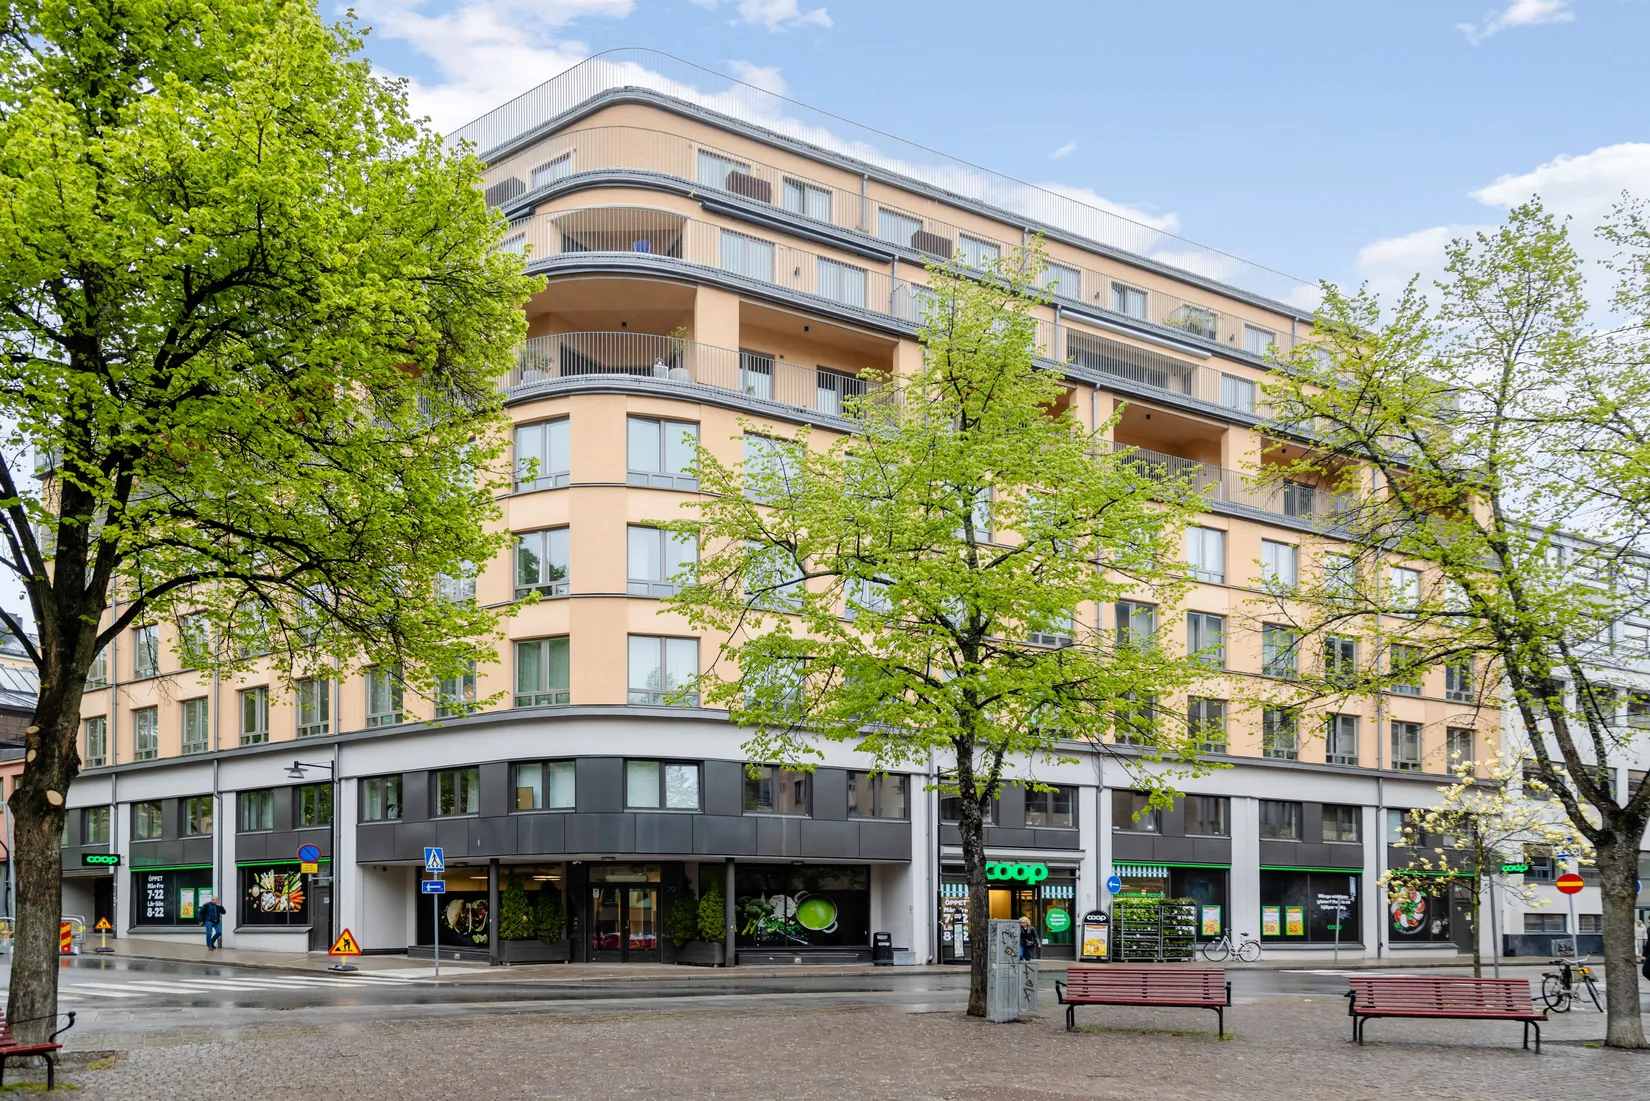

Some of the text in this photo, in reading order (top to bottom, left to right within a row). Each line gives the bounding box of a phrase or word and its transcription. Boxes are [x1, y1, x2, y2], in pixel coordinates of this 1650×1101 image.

[86, 856, 118, 864] coop
[985, 862, 1049, 885] coop
[147, 890, 164, 900] 7-22
[944, 898, 966, 906] ÖPPET
[146, 907, 164, 917] 8-22
[1264, 924, 1275, 933] 50
[1288, 924, 1298, 933] 65
